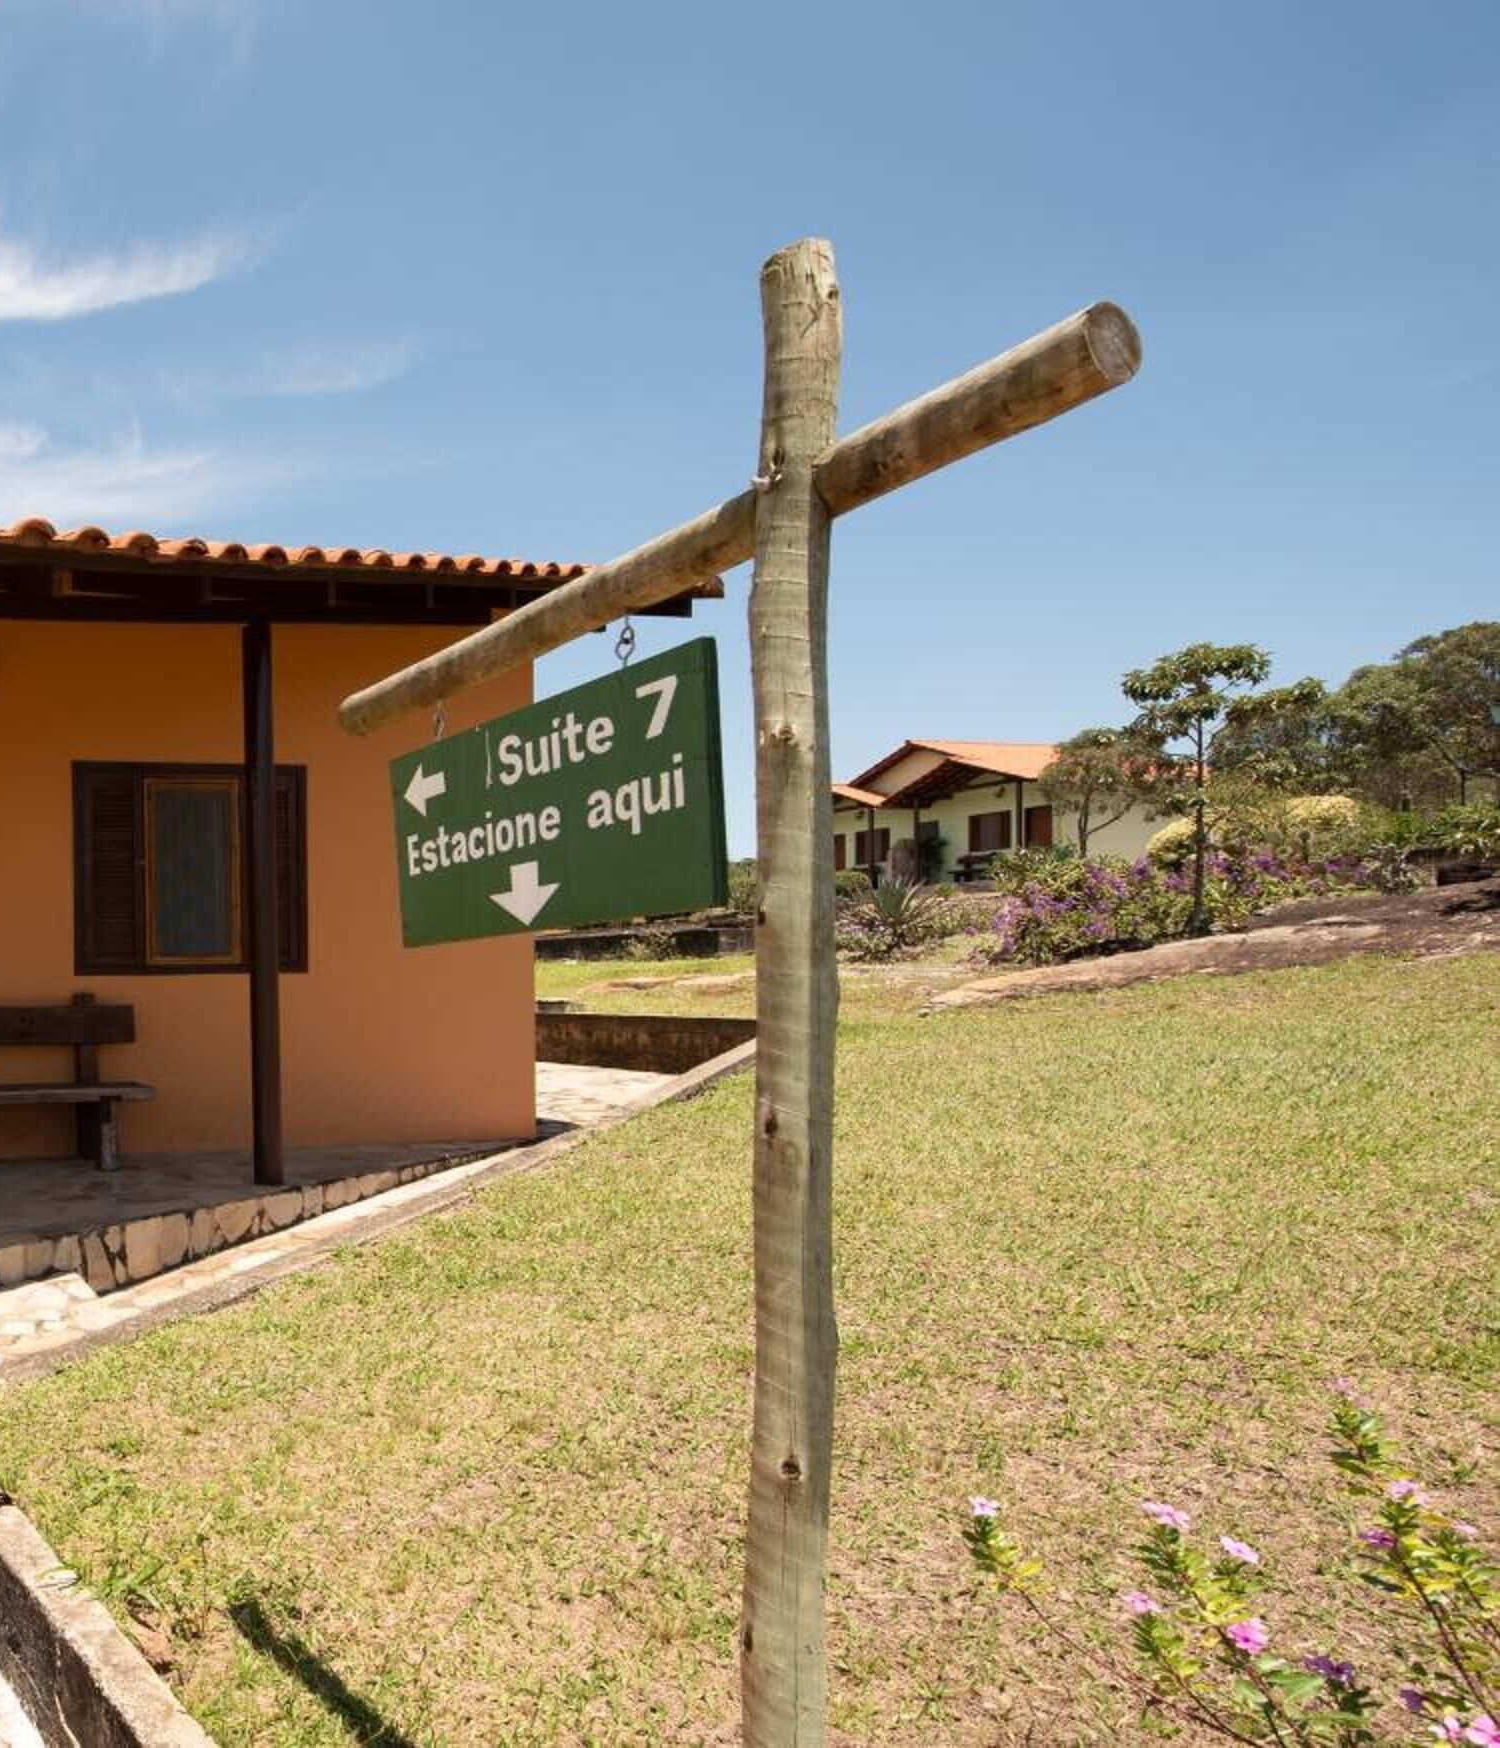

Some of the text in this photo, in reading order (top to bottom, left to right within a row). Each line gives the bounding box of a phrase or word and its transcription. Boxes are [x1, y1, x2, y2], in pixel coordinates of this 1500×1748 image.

[498, 674, 678, 786] Suite 7
[406, 752, 685, 877] Estacione aqui
